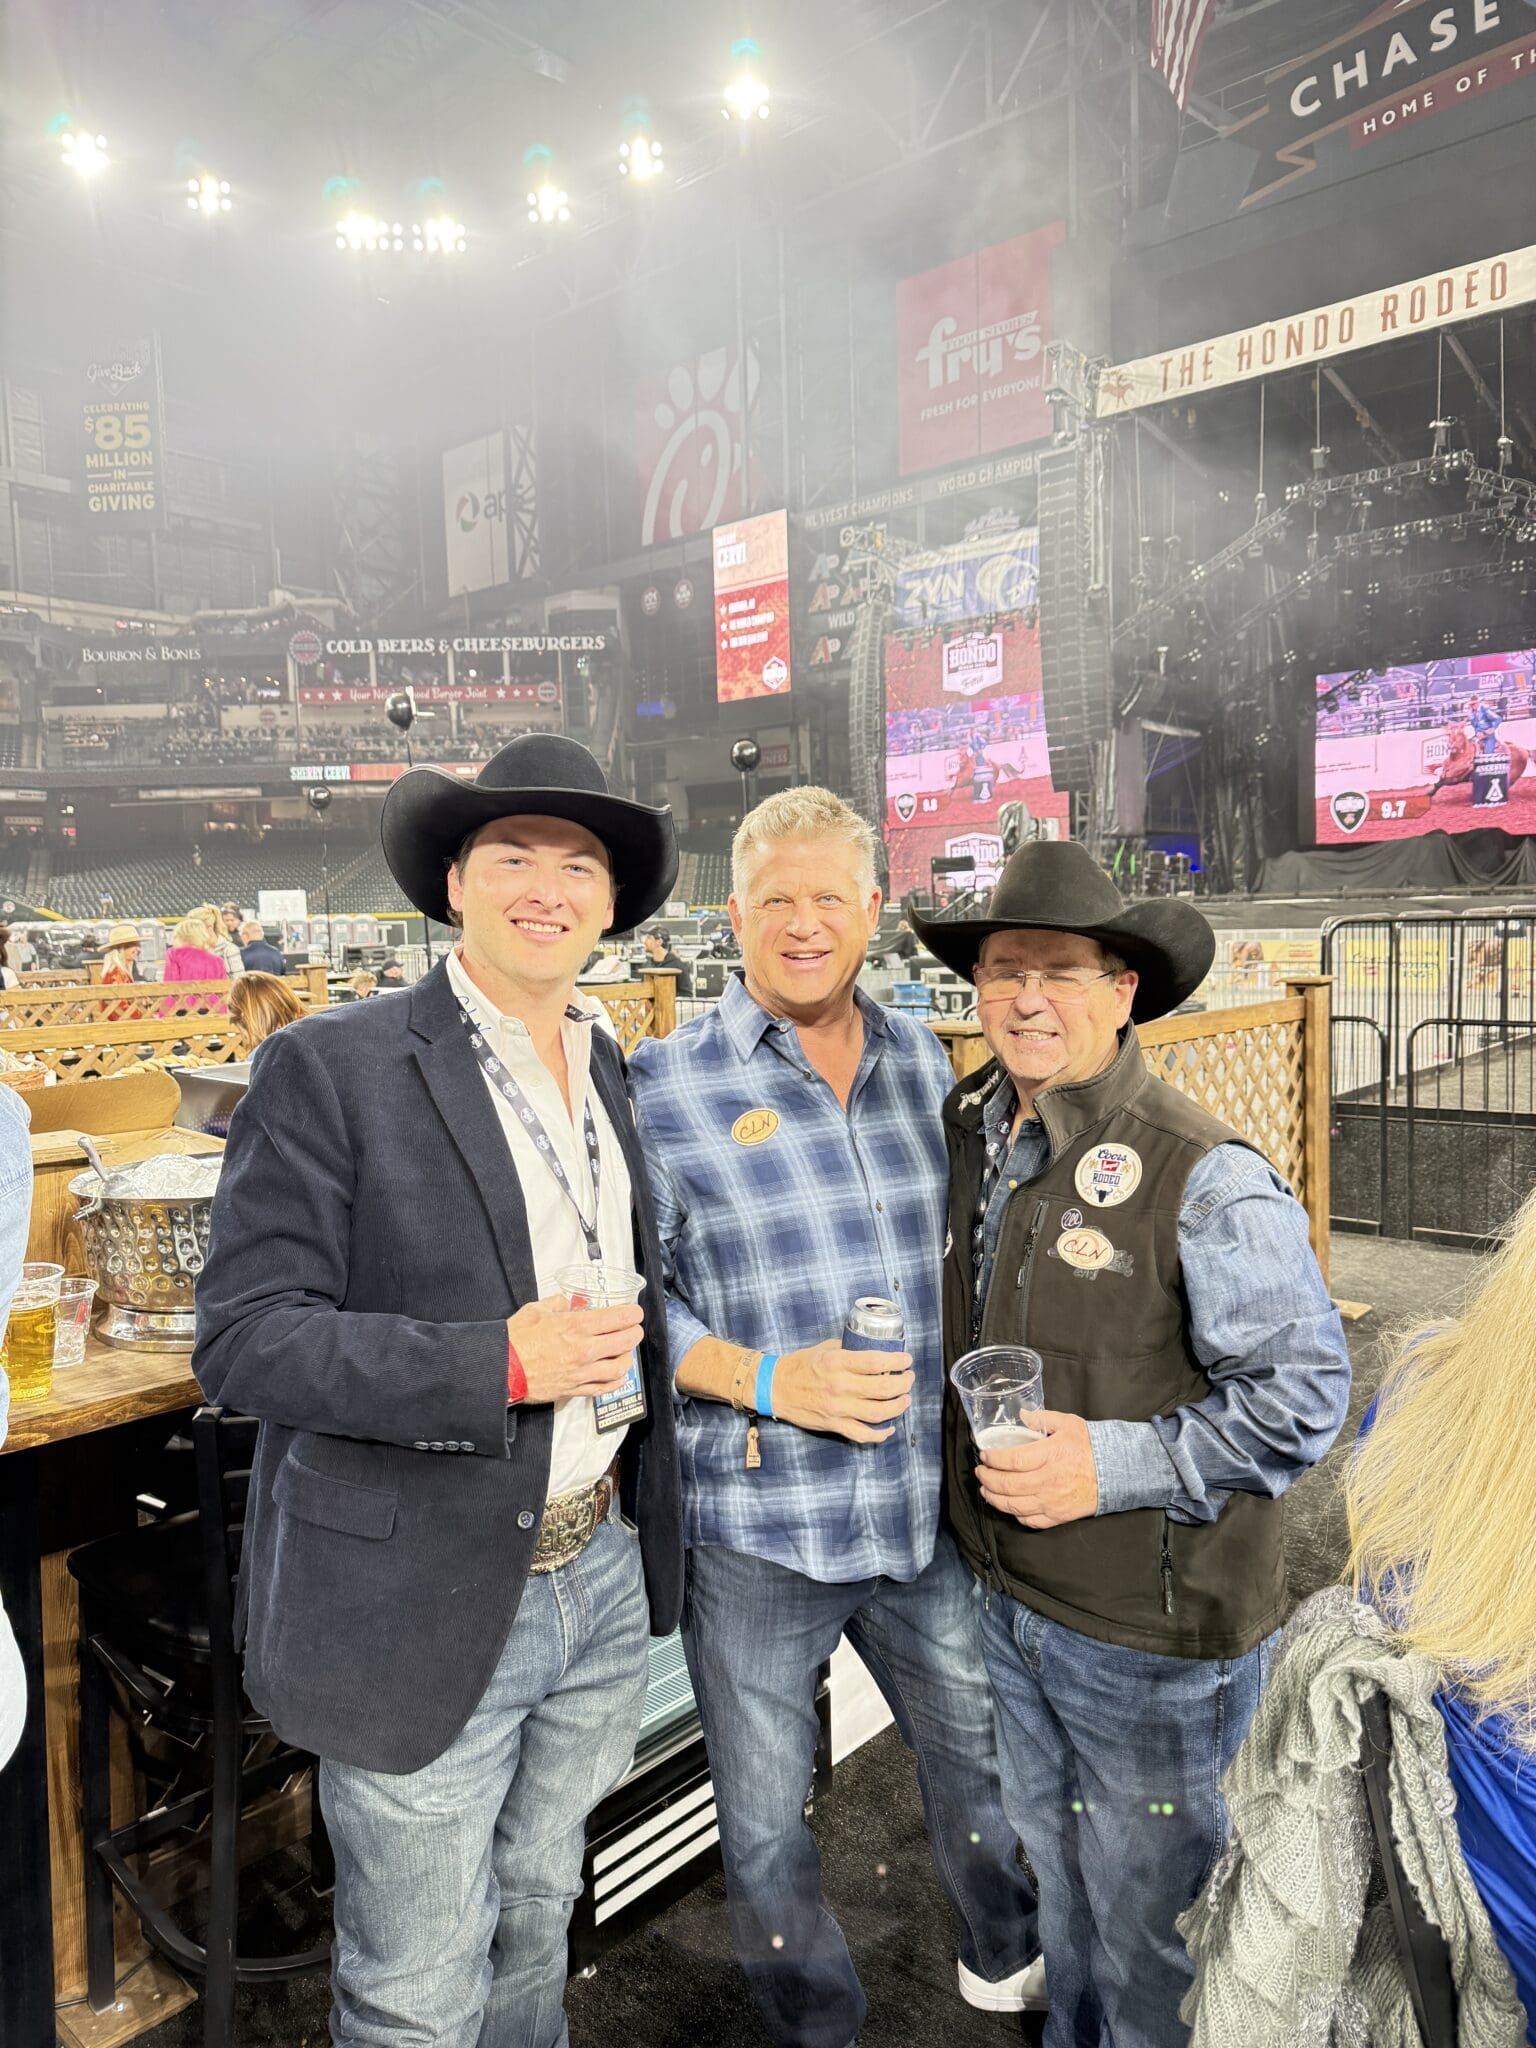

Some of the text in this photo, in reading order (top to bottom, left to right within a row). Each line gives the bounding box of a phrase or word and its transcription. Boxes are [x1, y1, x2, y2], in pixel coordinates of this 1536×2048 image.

[1290, 0, 1500, 117] CHASE
[1363, 49, 1536, 135] HOME OF TH
[1160, 260, 1508, 394] THE HONDO RODEO
[83, 400, 150, 414] CELEBRATING
[920, 376, 1041, 422] FRESH FOR EVERYONE
[84, 413, 152, 450] $85
[85, 451, 154, 468] MILLION
[112, 469, 127, 481] IN
[937, 455, 1040, 496] WORLD CHAMPION
[87, 481, 155, 494] CHARITABLE
[88, 494, 156, 513] GIVING
[850, 486, 913, 516] CHAMPIONS
[904, 569, 964, 610] ZYN
[828, 609, 855, 630] WILD
[145, 646, 158, 660] &
[326, 638, 373, 654] COLD
[377, 637, 435, 654] BEERS
[438, 639, 450, 653] &
[453, 635, 606, 652] CHEESEBURGERS
[949, 641, 997, 668] HONDO
[350, 689, 371, 701] Your
[431, 687, 464, 702] Burger
[464, 686, 488, 699] Joint
[739, 1113, 770, 1140] CLN
[1097, 1148, 1127, 1162] Coors
[1093, 1172, 1121, 1186] RODEO
[1063, 1239, 1109, 1260] CLN
